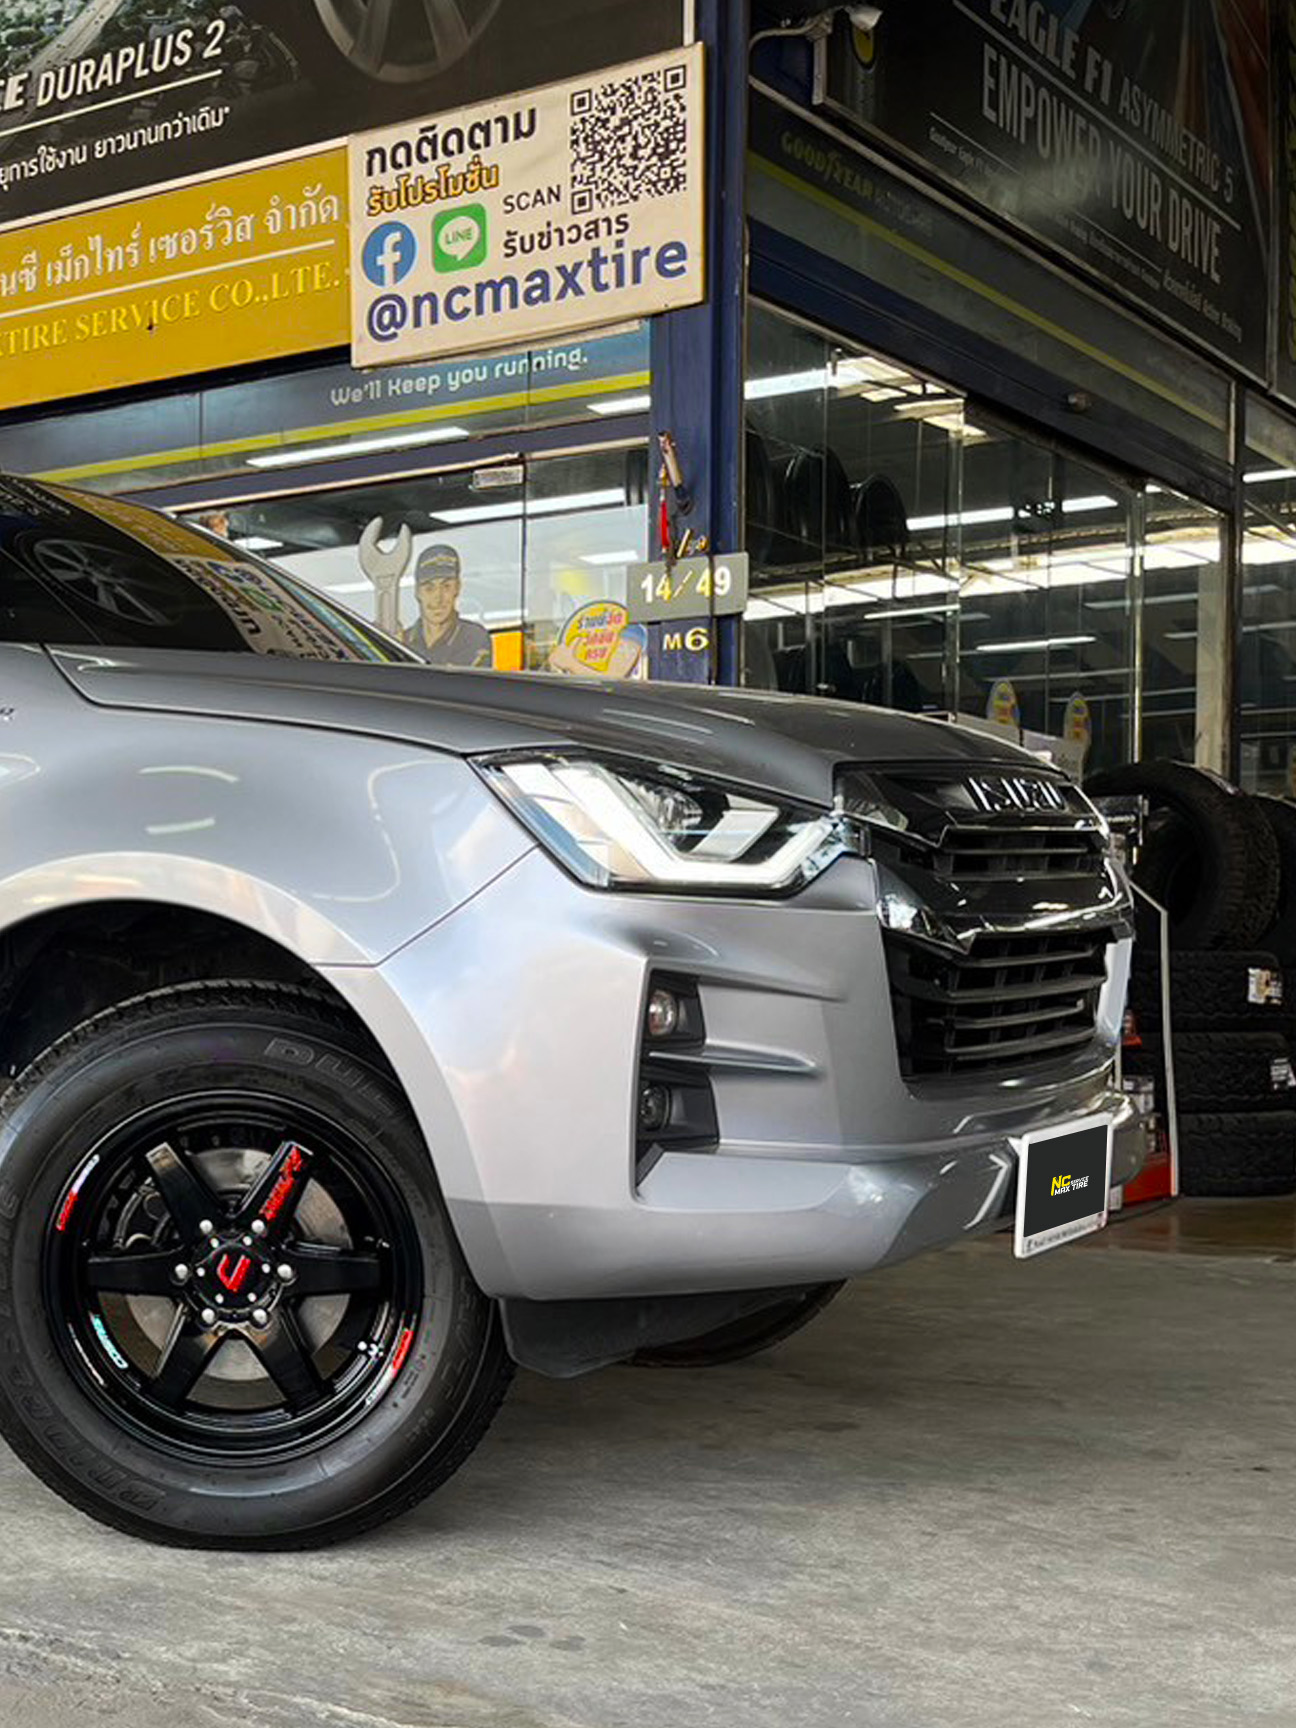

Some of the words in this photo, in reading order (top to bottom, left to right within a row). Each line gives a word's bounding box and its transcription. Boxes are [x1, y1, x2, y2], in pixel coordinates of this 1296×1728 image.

[37, 36, 193, 108] DURAPLUS
[203, 19, 227, 58] 2
[365, 106, 538, 177] กดติดตาม
[1083, 46, 1114, 106] F1
[1117, 76, 1222, 192] ASYMMETRIC
[1223, 169, 1235, 204] 5
[367, 155, 500, 217] รับโปรโมชั่น
[982, 42, 1102, 198] EMPOWER
[1109, 139, 1163, 242] YOUR
[1167, 187, 1223, 285] DRIVE
[503, 184, 563, 215] SCAN
[46, 220, 142, 287] เม็กไทร์
[150, 202, 256, 263] เซอร์วิส
[263, 182, 340, 235] จำกัด
[444, 227, 474, 246] LINE
[503, 213, 630, 259] รับข่าวสาร
[75, 289, 201, 341] SERVICE
[366, 239, 689, 343] @ncmaxtire
[330, 378, 383, 407] We'll
[387, 371, 441, 401] Keep
[447, 364, 489, 392] you
[494, 347, 589, 382] running.
[640, 566, 732, 604] 14/49
